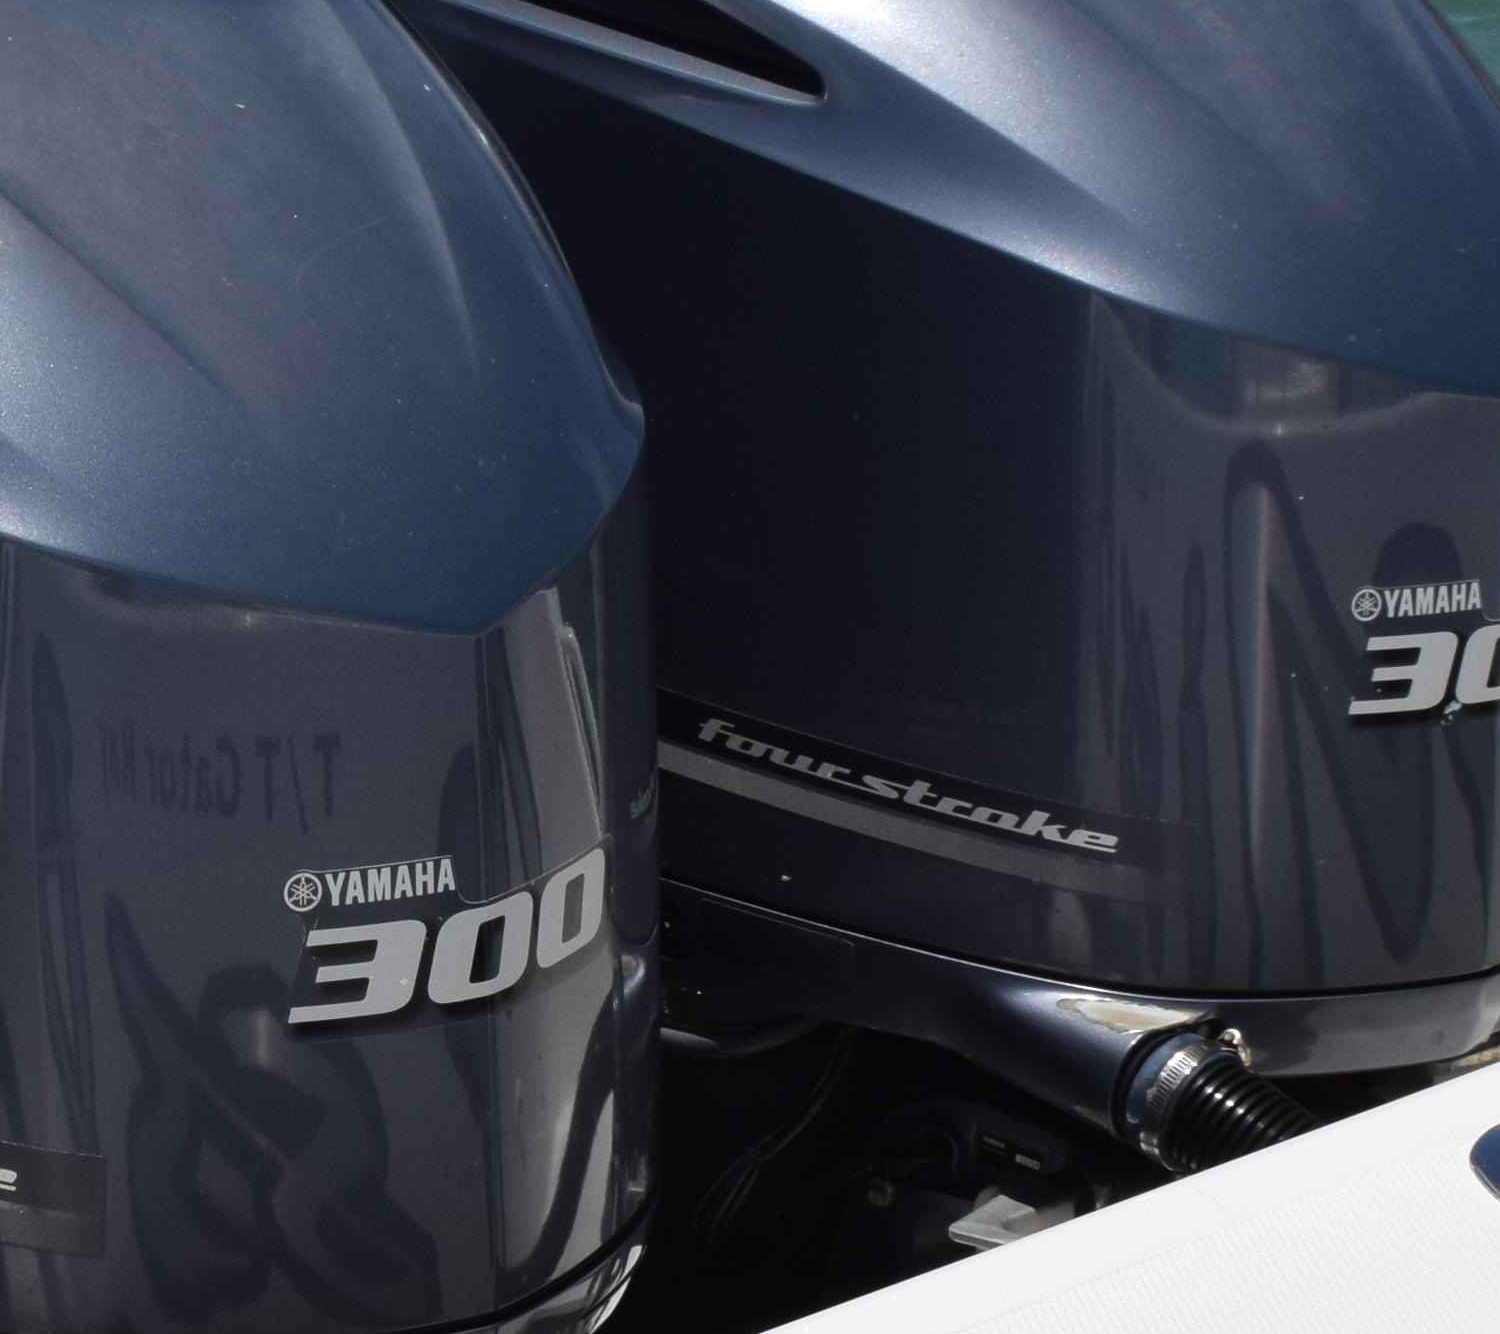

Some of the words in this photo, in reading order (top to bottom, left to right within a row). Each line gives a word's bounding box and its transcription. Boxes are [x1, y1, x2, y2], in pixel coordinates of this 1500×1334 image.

[1384, 582, 1482, 618] YAMAHA
[325, 858, 456, 907] YAMAHA
[288, 848, 606, 1024] 300
